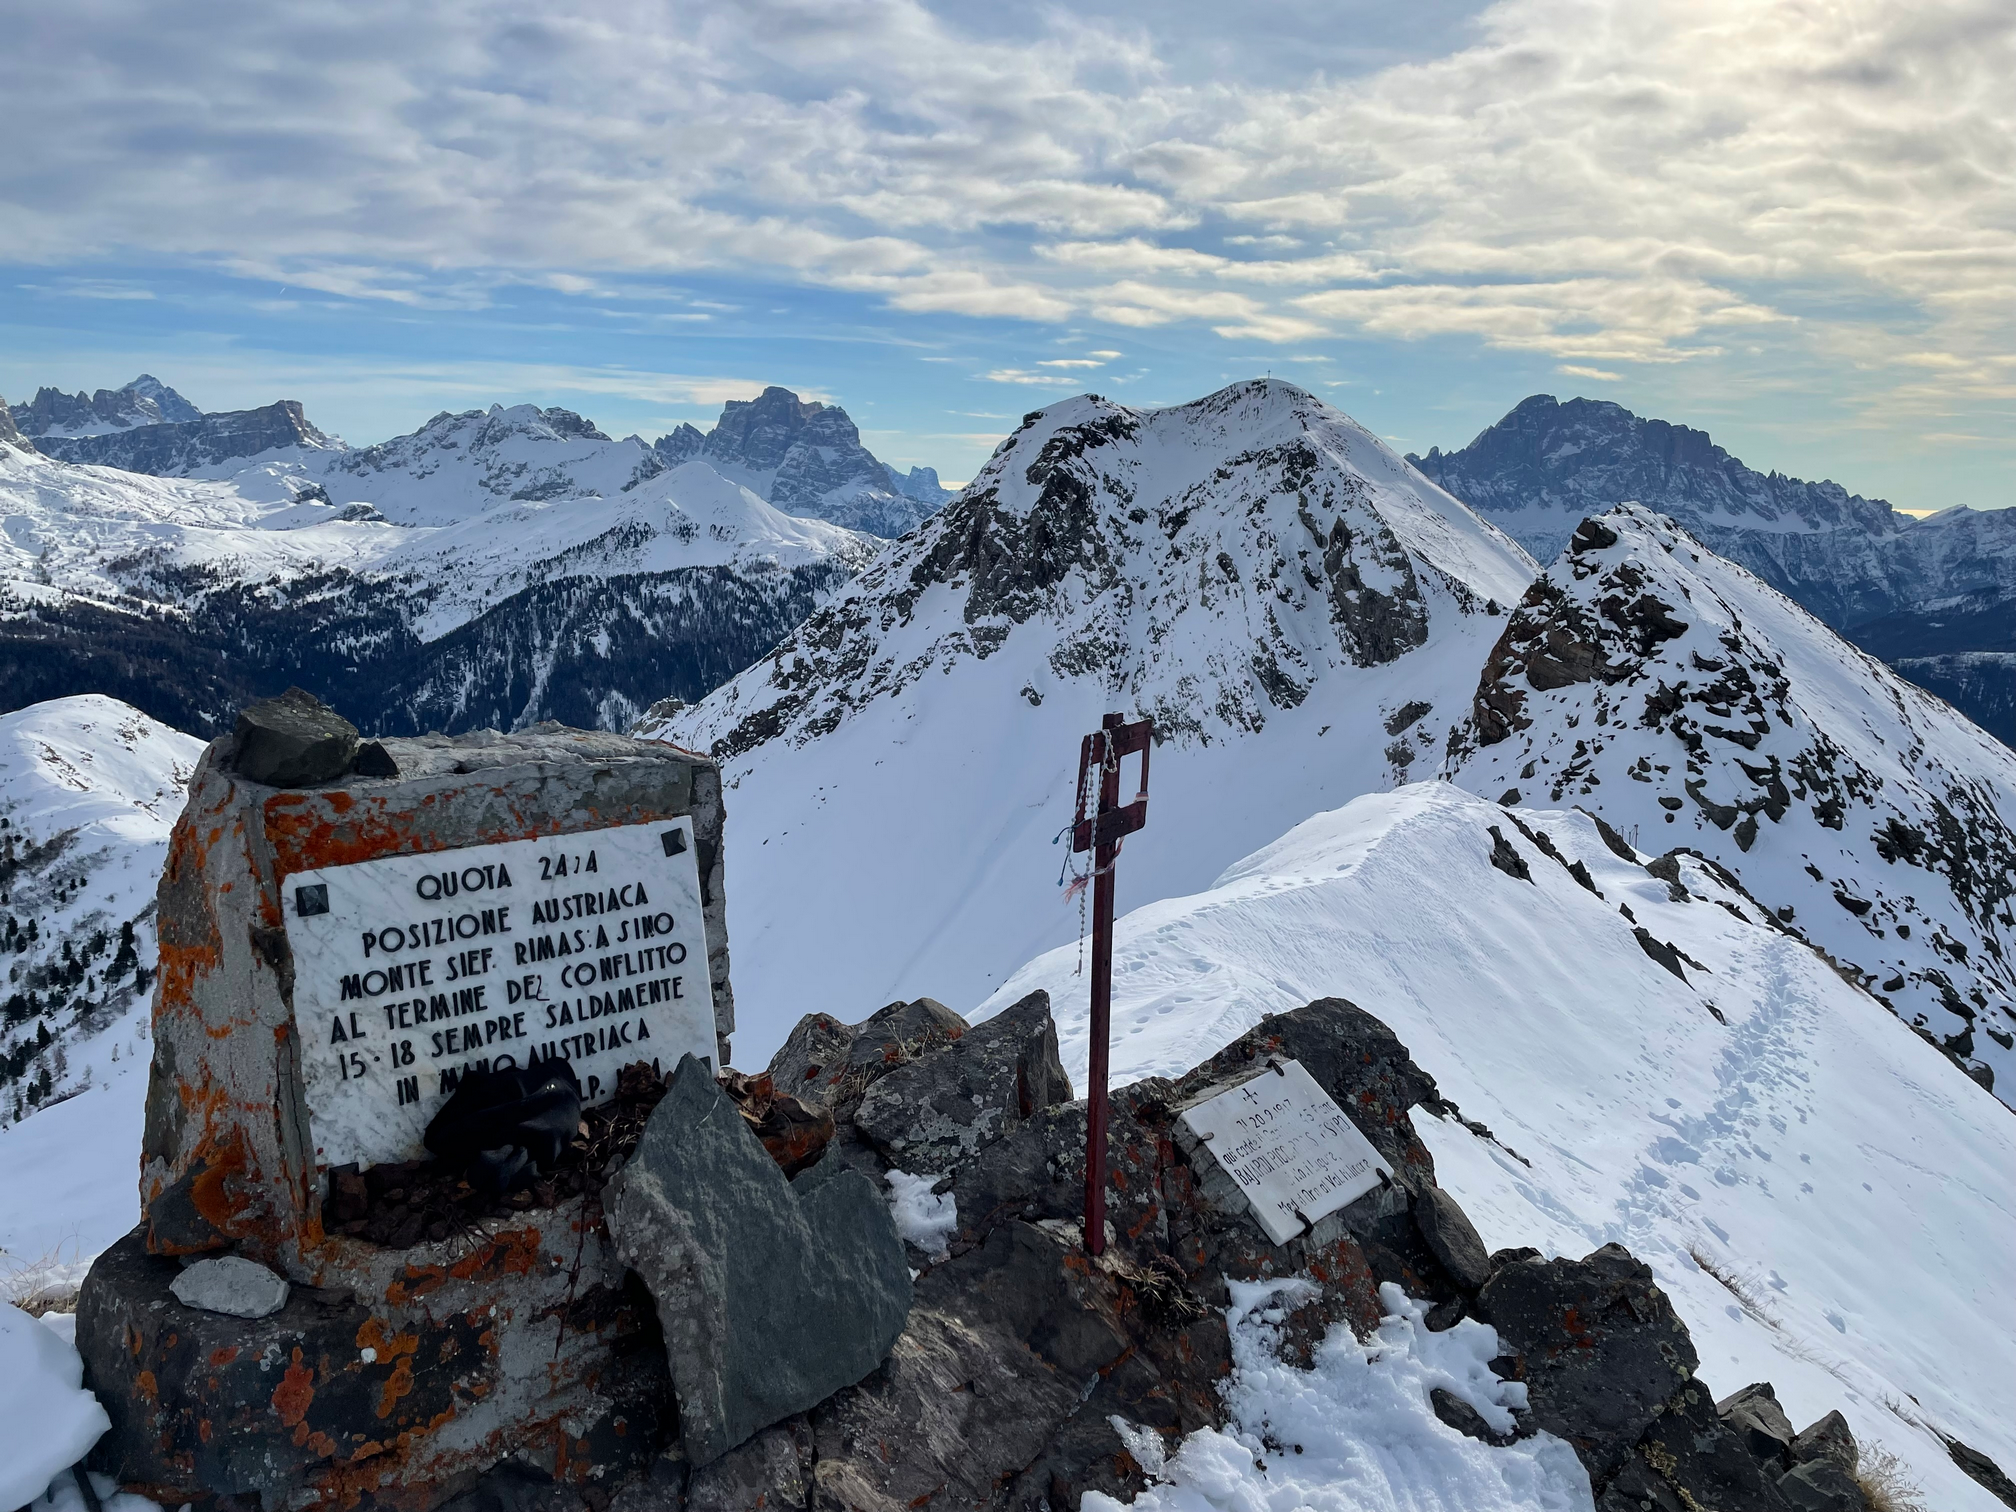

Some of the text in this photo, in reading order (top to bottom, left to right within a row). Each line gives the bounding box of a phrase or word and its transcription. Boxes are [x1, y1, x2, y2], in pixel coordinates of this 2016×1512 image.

[362, 882, 648, 958] POSIZIONE AUSTRIACA
[417, 863, 512, 900] QUOTA
[330, 1012, 366, 1044] AL
[383, 985, 488, 1030] TERMINE
[561, 942, 686, 988] CONFLITTO
[340, 960, 433, 1001] MONTE
[515, 924, 609, 965] RIMASA
[617, 913, 674, 942] SINO
[432, 1012, 527, 1058] SEMPRE
[546, 976, 683, 1028] SALDAMENTE
[397, 1075, 421, 1106] IN
[529, 1018, 650, 1066] AUSTRIACA
